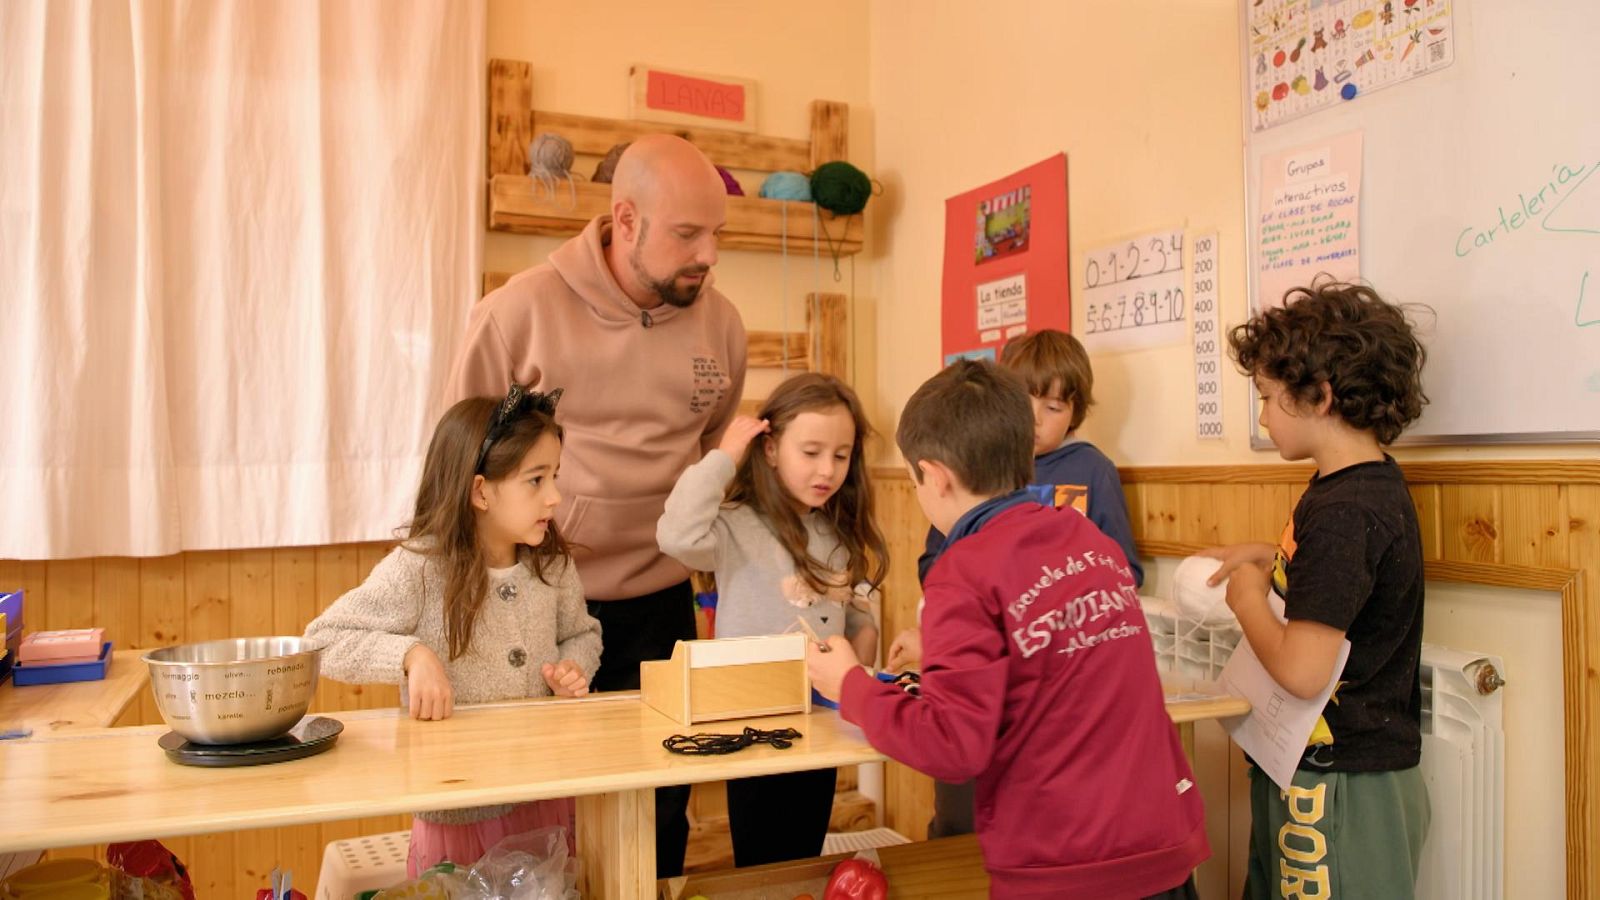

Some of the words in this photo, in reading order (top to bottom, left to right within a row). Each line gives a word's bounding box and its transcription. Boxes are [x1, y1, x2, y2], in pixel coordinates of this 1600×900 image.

[662, 79, 741, 115] LANAS
[1287, 159, 1325, 176] Grupos
[1456, 164, 1585, 257] Cartelería
[1195, 239, 1211, 254] 100
[1195, 259, 1213, 274] 200
[980, 291, 991, 303] La
[995, 282, 1022, 300] tienda
[1195, 279, 1213, 294] 300
[1194, 299, 1213, 313] 400
[1195, 319, 1214, 334] 500
[1196, 340, 1215, 354] 600
[1197, 361, 1216, 374] 700
[1198, 381, 1217, 394] 800
[1198, 402, 1218, 415] 900
[1199, 422, 1222, 435] 1000
[1066, 555, 1087, 576] de
[267, 663, 304, 675] rebanada
